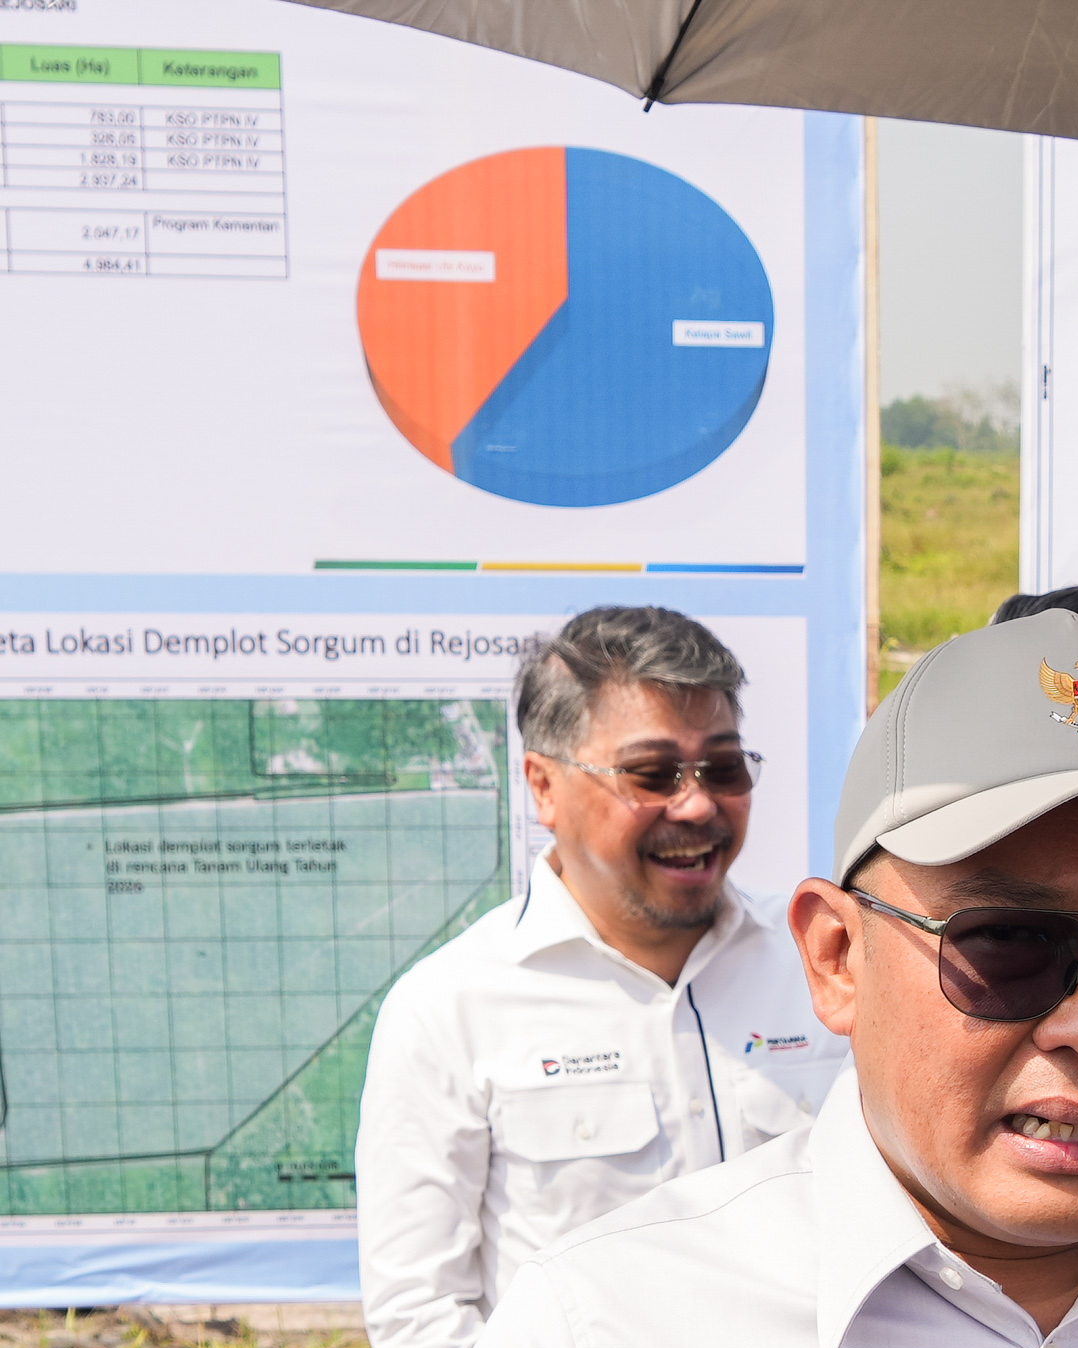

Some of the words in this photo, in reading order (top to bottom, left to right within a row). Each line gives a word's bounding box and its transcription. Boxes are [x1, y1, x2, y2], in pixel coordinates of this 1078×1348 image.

[30, 57, 70, 73] Luas
[76, 59, 110, 77] (Ha)
[163, 61, 258, 81] Keterangan
[165, 112, 196, 126] KSO
[166, 132, 197, 146] KSO
[167, 153, 198, 167] KSO
[153, 216, 208, 232] Program
[213, 218, 279, 232] Kementan
[46, 628, 133, 655] Lokasi
[144, 628, 267, 660] Demplot
[277, 629, 385, 661] Sorgum
[395, 629, 420, 655] di
[105, 839, 151, 854] Lokasi
[159, 839, 221, 856] demplot
[227, 841, 280, 855] sorgum
[106, 860, 119, 874] di
[125, 861, 187, 874] rencana
[193, 859, 240, 874] Tanam
[246, 859, 288, 875] Ulang
[295, 858, 337, 873] Tahun
